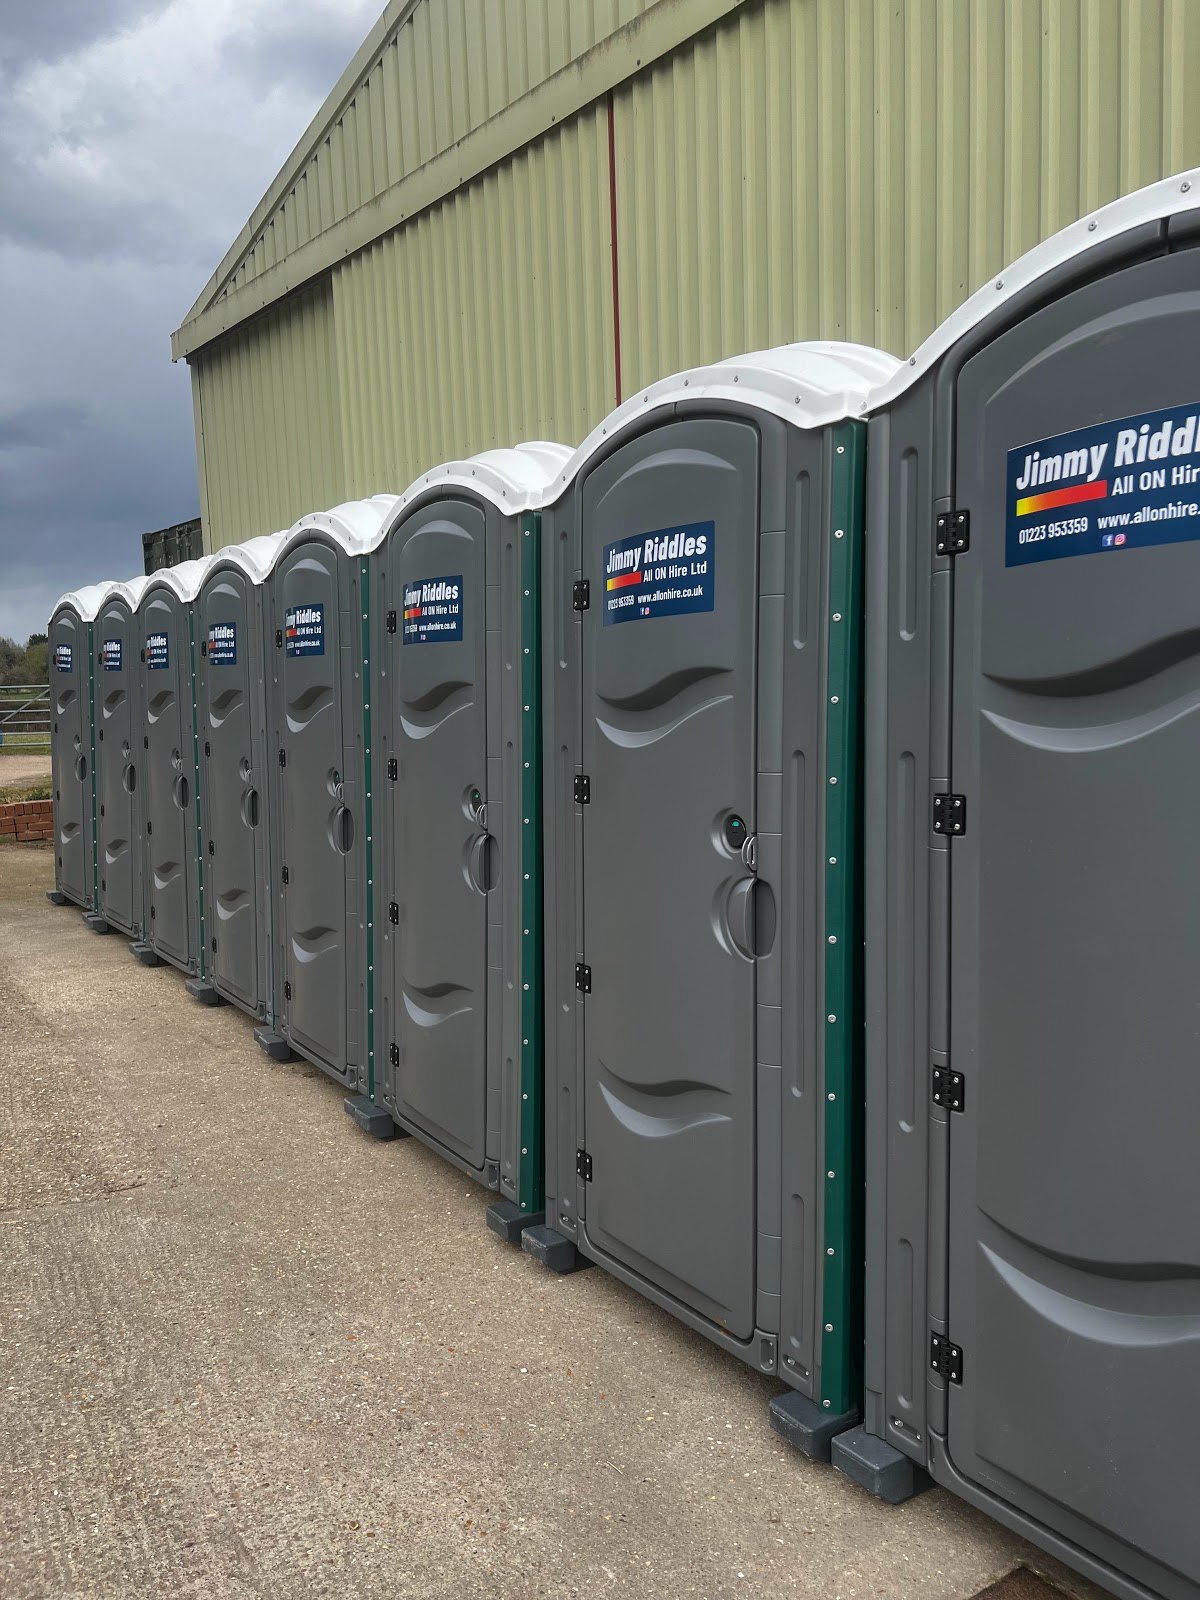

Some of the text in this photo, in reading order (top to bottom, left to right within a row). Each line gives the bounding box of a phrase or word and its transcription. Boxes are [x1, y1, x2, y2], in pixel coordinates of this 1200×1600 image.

[1016, 443, 1109, 490] Jimmy
[1111, 474, 1134, 496] All
[1139, 469, 1166, 491] ON
[1018, 527, 1046, 545] 01223
[1047, 517, 1089, 538] 953359
[606, 532, 707, 574] Jimmy Riddles
[643, 560, 707, 583] All ON Hire Ltd
[422, 582, 459, 602] Riddles
[637, 584, 703, 604] www.allonhire.co.uk
[296, 609, 321, 624] Riddles
[436, 605, 447, 614] Hire
[449, 604, 458, 613] Ltd
[151, 636, 166, 646] Riddles
[215, 626, 234, 638] Riddles
